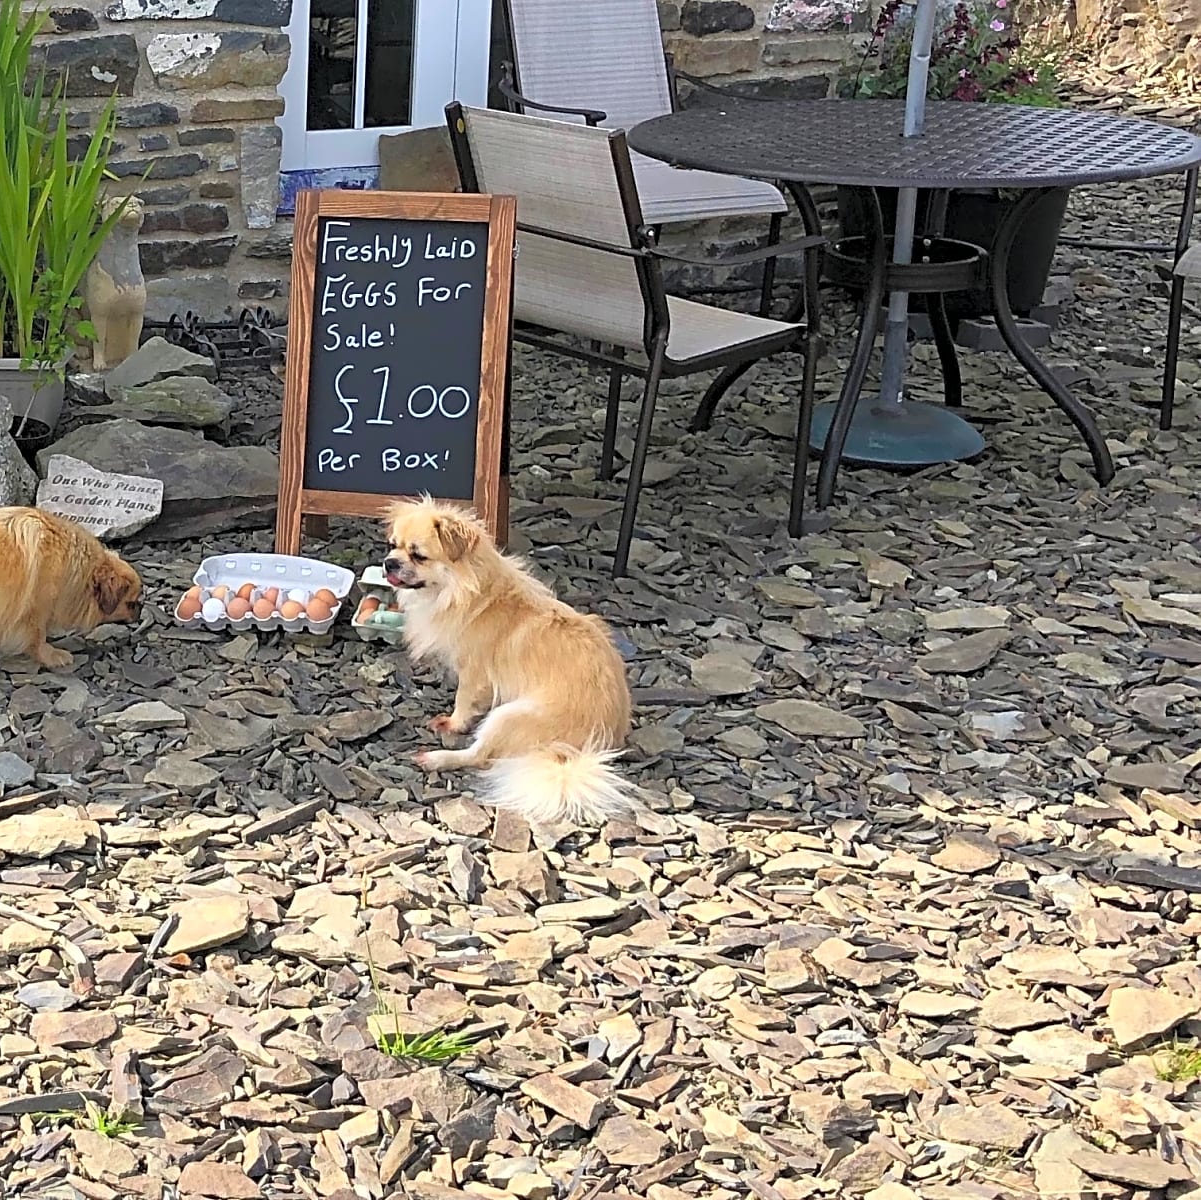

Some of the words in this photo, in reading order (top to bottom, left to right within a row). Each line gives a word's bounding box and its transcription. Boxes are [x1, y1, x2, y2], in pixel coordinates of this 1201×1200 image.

[321, 221, 412, 268] Freshly
[321, 274, 397, 316] EGGS
[324, 323, 395, 351] Sale!
[332, 364, 471, 434] £1.00
[318, 448, 361, 473] Per
[52, 474, 79, 486] One
[81, 477, 110, 490] Who
[115, 481, 159, 494] Plants
[50, 495, 59, 503] a
[64, 494, 111, 508] Garden
[115, 498, 156, 513] Plants
